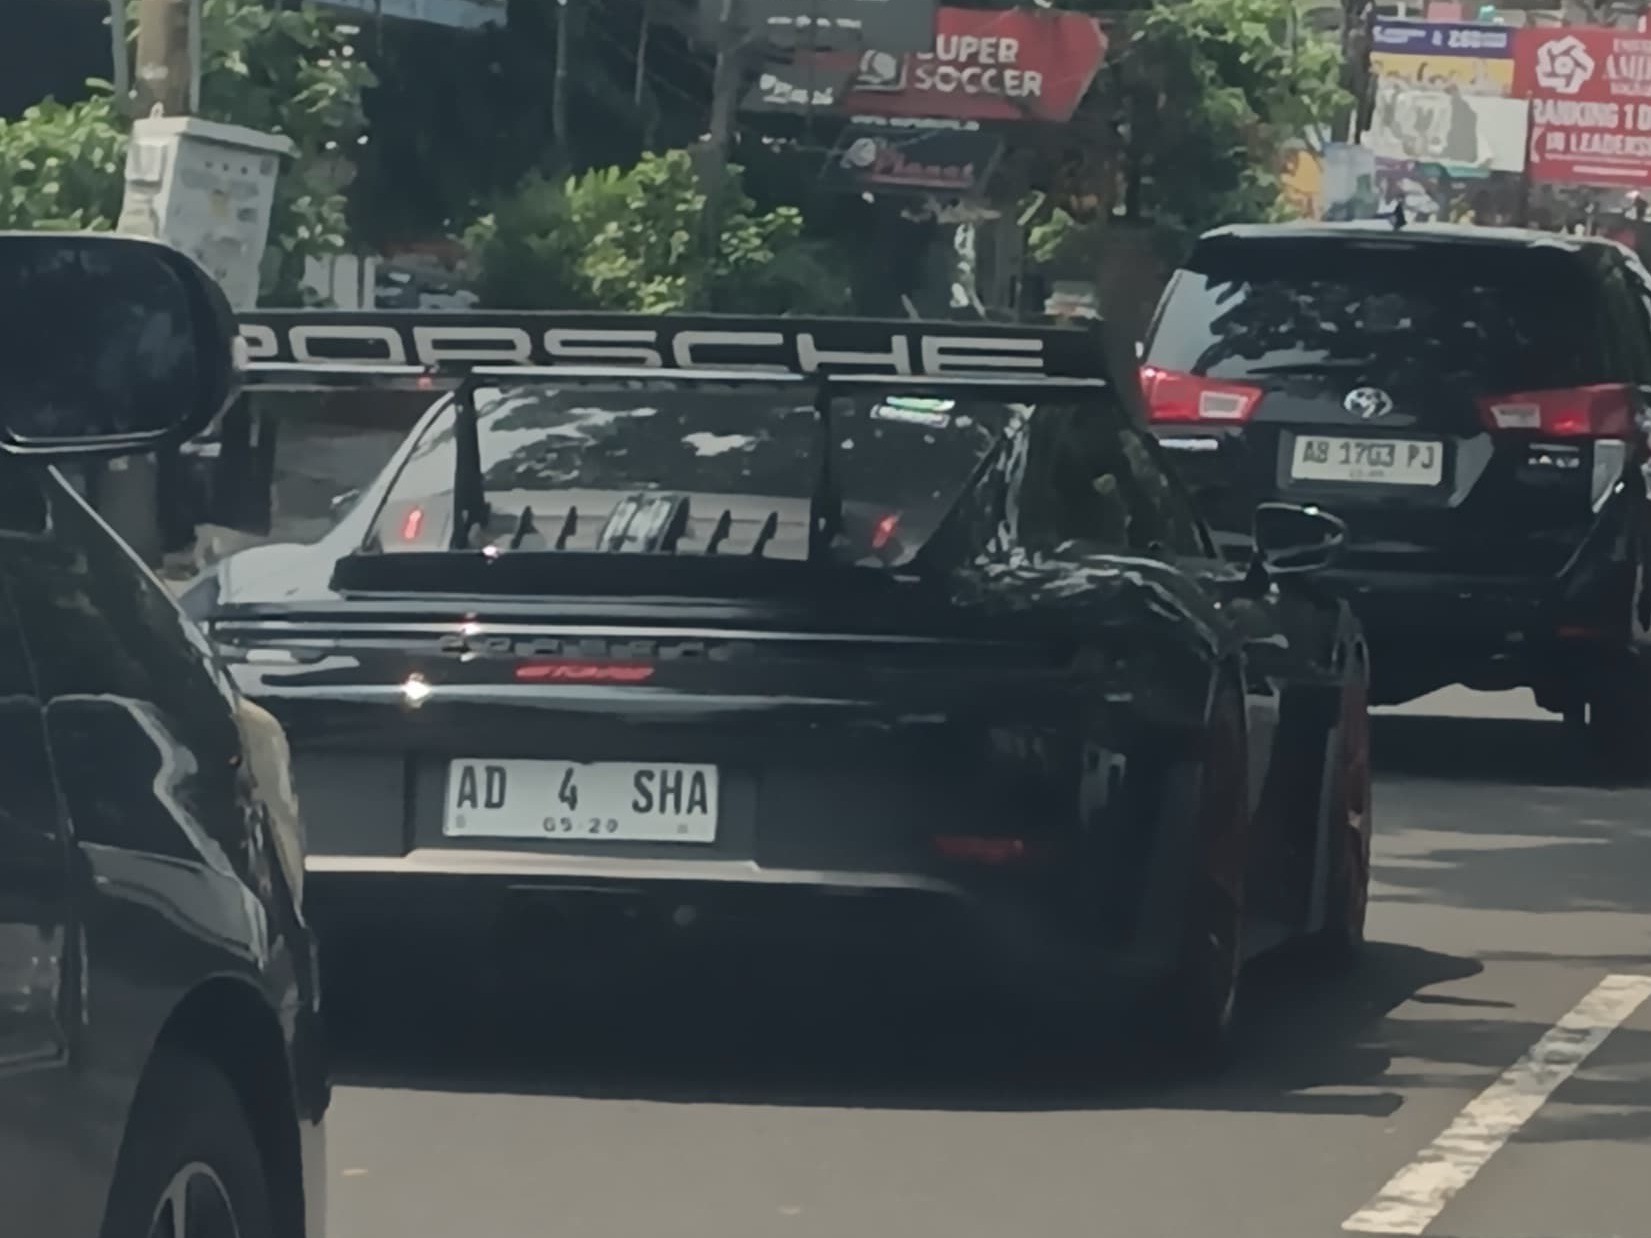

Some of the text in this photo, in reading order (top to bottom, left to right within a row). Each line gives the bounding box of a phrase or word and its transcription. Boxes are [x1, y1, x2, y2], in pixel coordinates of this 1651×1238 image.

[917, 33, 1019, 64] UPER
[914, 66, 1042, 97] SOCCER
[1303, 441, 1328, 462] AB
[1407, 444, 1434, 469] PJ
[456, 765, 708, 814] AD 4 SHA
